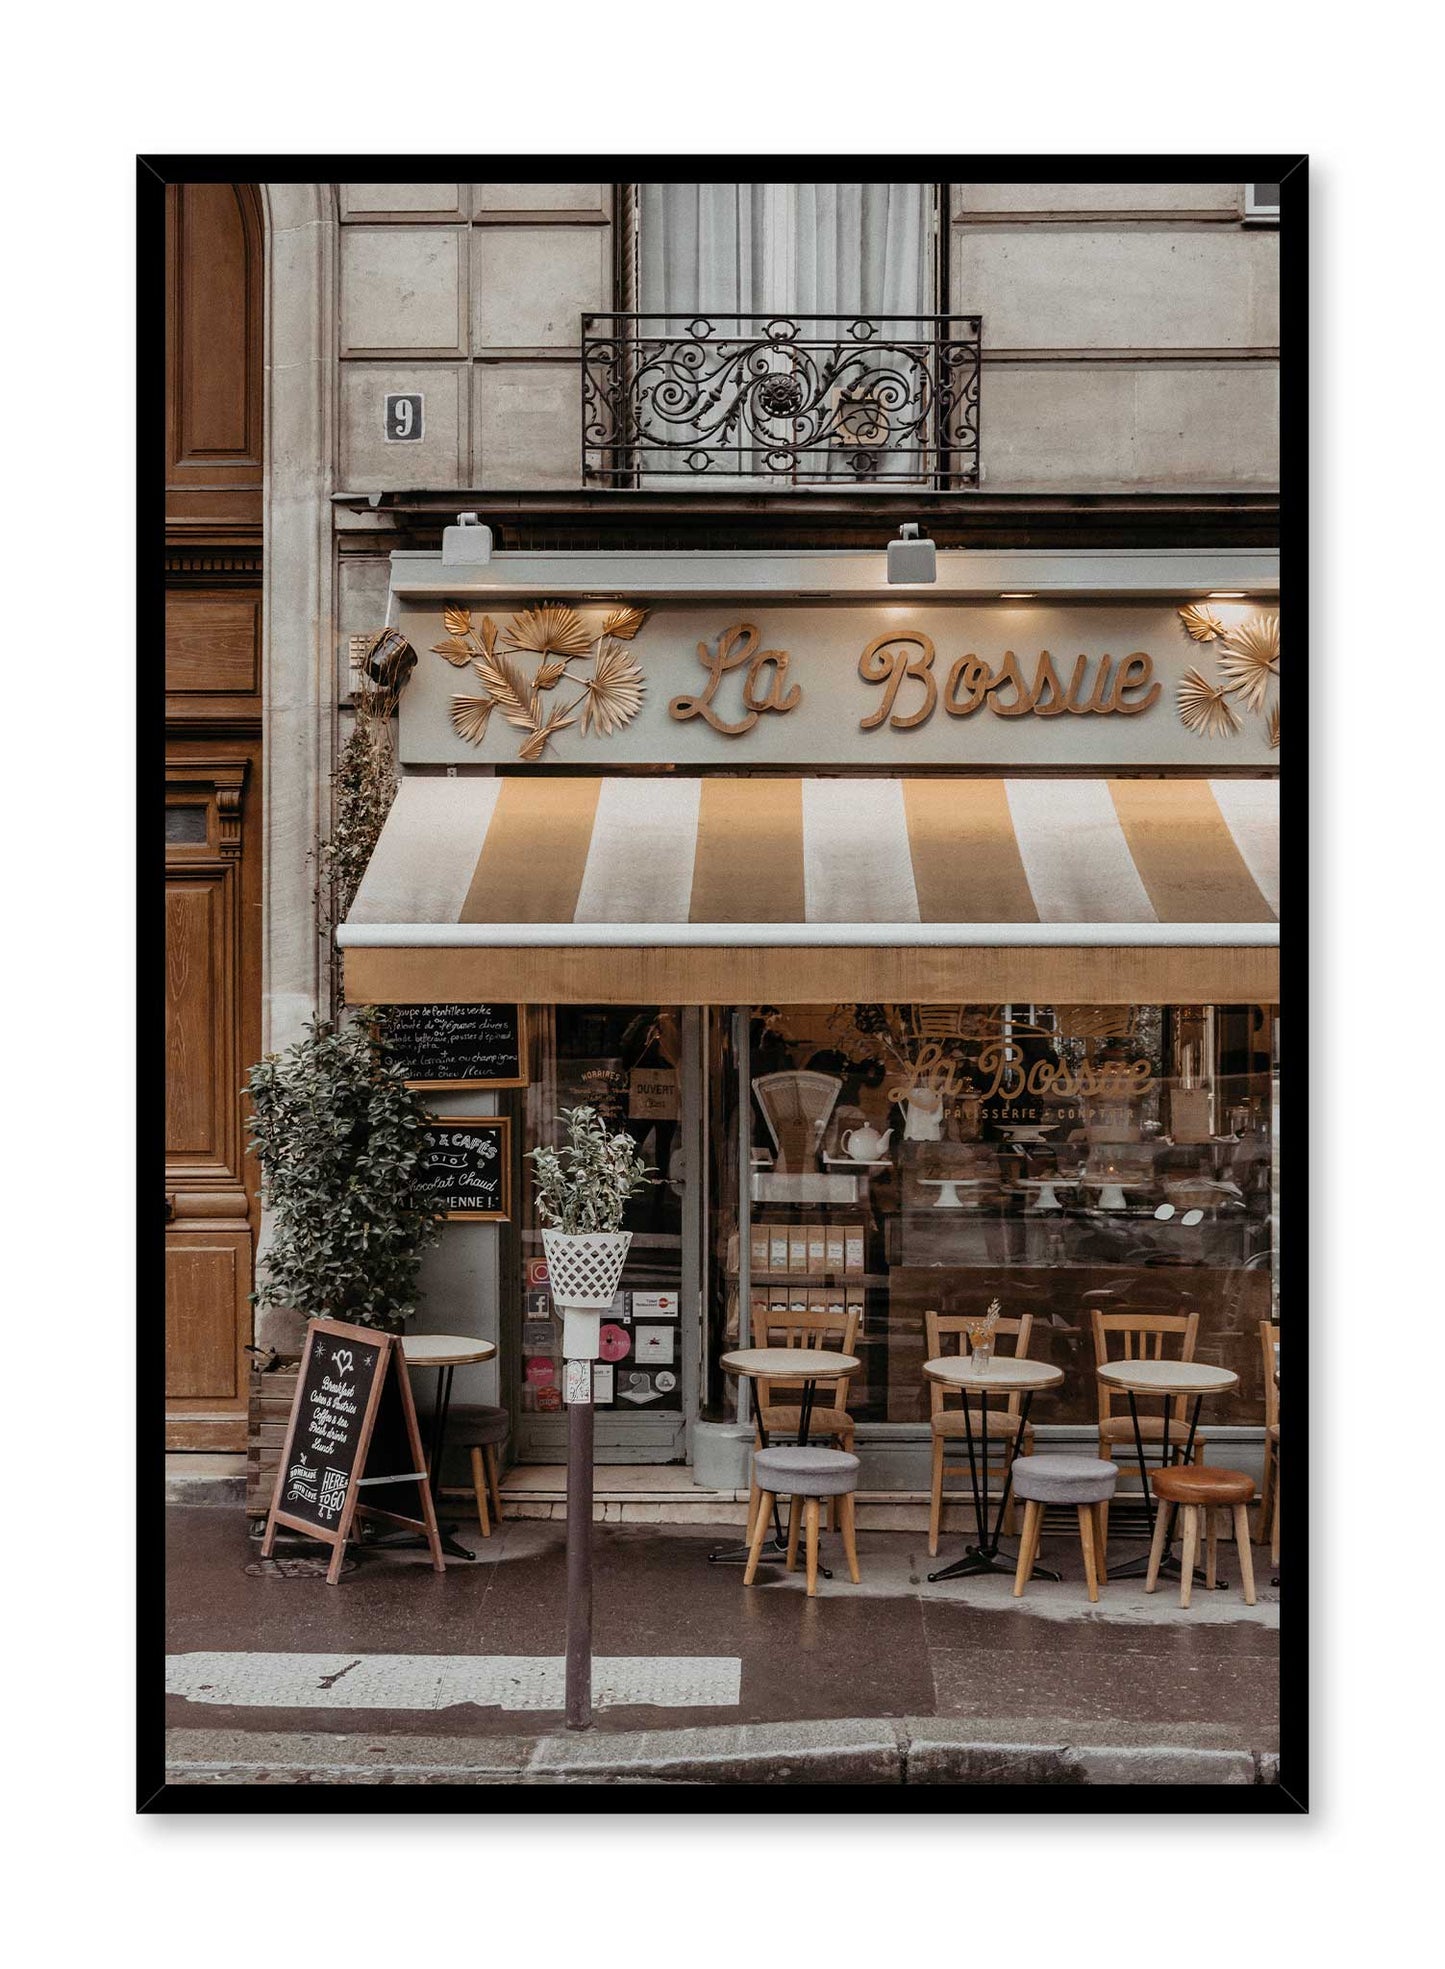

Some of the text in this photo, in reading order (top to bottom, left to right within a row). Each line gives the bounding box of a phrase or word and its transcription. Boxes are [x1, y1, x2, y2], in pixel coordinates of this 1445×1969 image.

[395, 399, 413, 437] 9
[668, 623, 1163, 735] La Bossue
[479, 1018, 509, 1029] divers
[888, 1042, 1156, 1112] La Bossue
[637, 1084, 675, 1095] OUVERT
[944, 1105, 1134, 1120] PÂISSERIE COMPTR
[452, 1133, 498, 1159] CAFÉS
[431, 1154, 458, 1165] BIO
[458, 1171, 498, 1192] Chaud
[321, 1375, 355, 1399] Breakfast
[310, 1390, 327, 1405] Cakes
[311, 1437, 335, 1455] Lunch
[290, 1468, 317, 1479] HOMEMADE
[321, 1471, 346, 1492] HERE
[330, 1491, 345, 1511] GO
